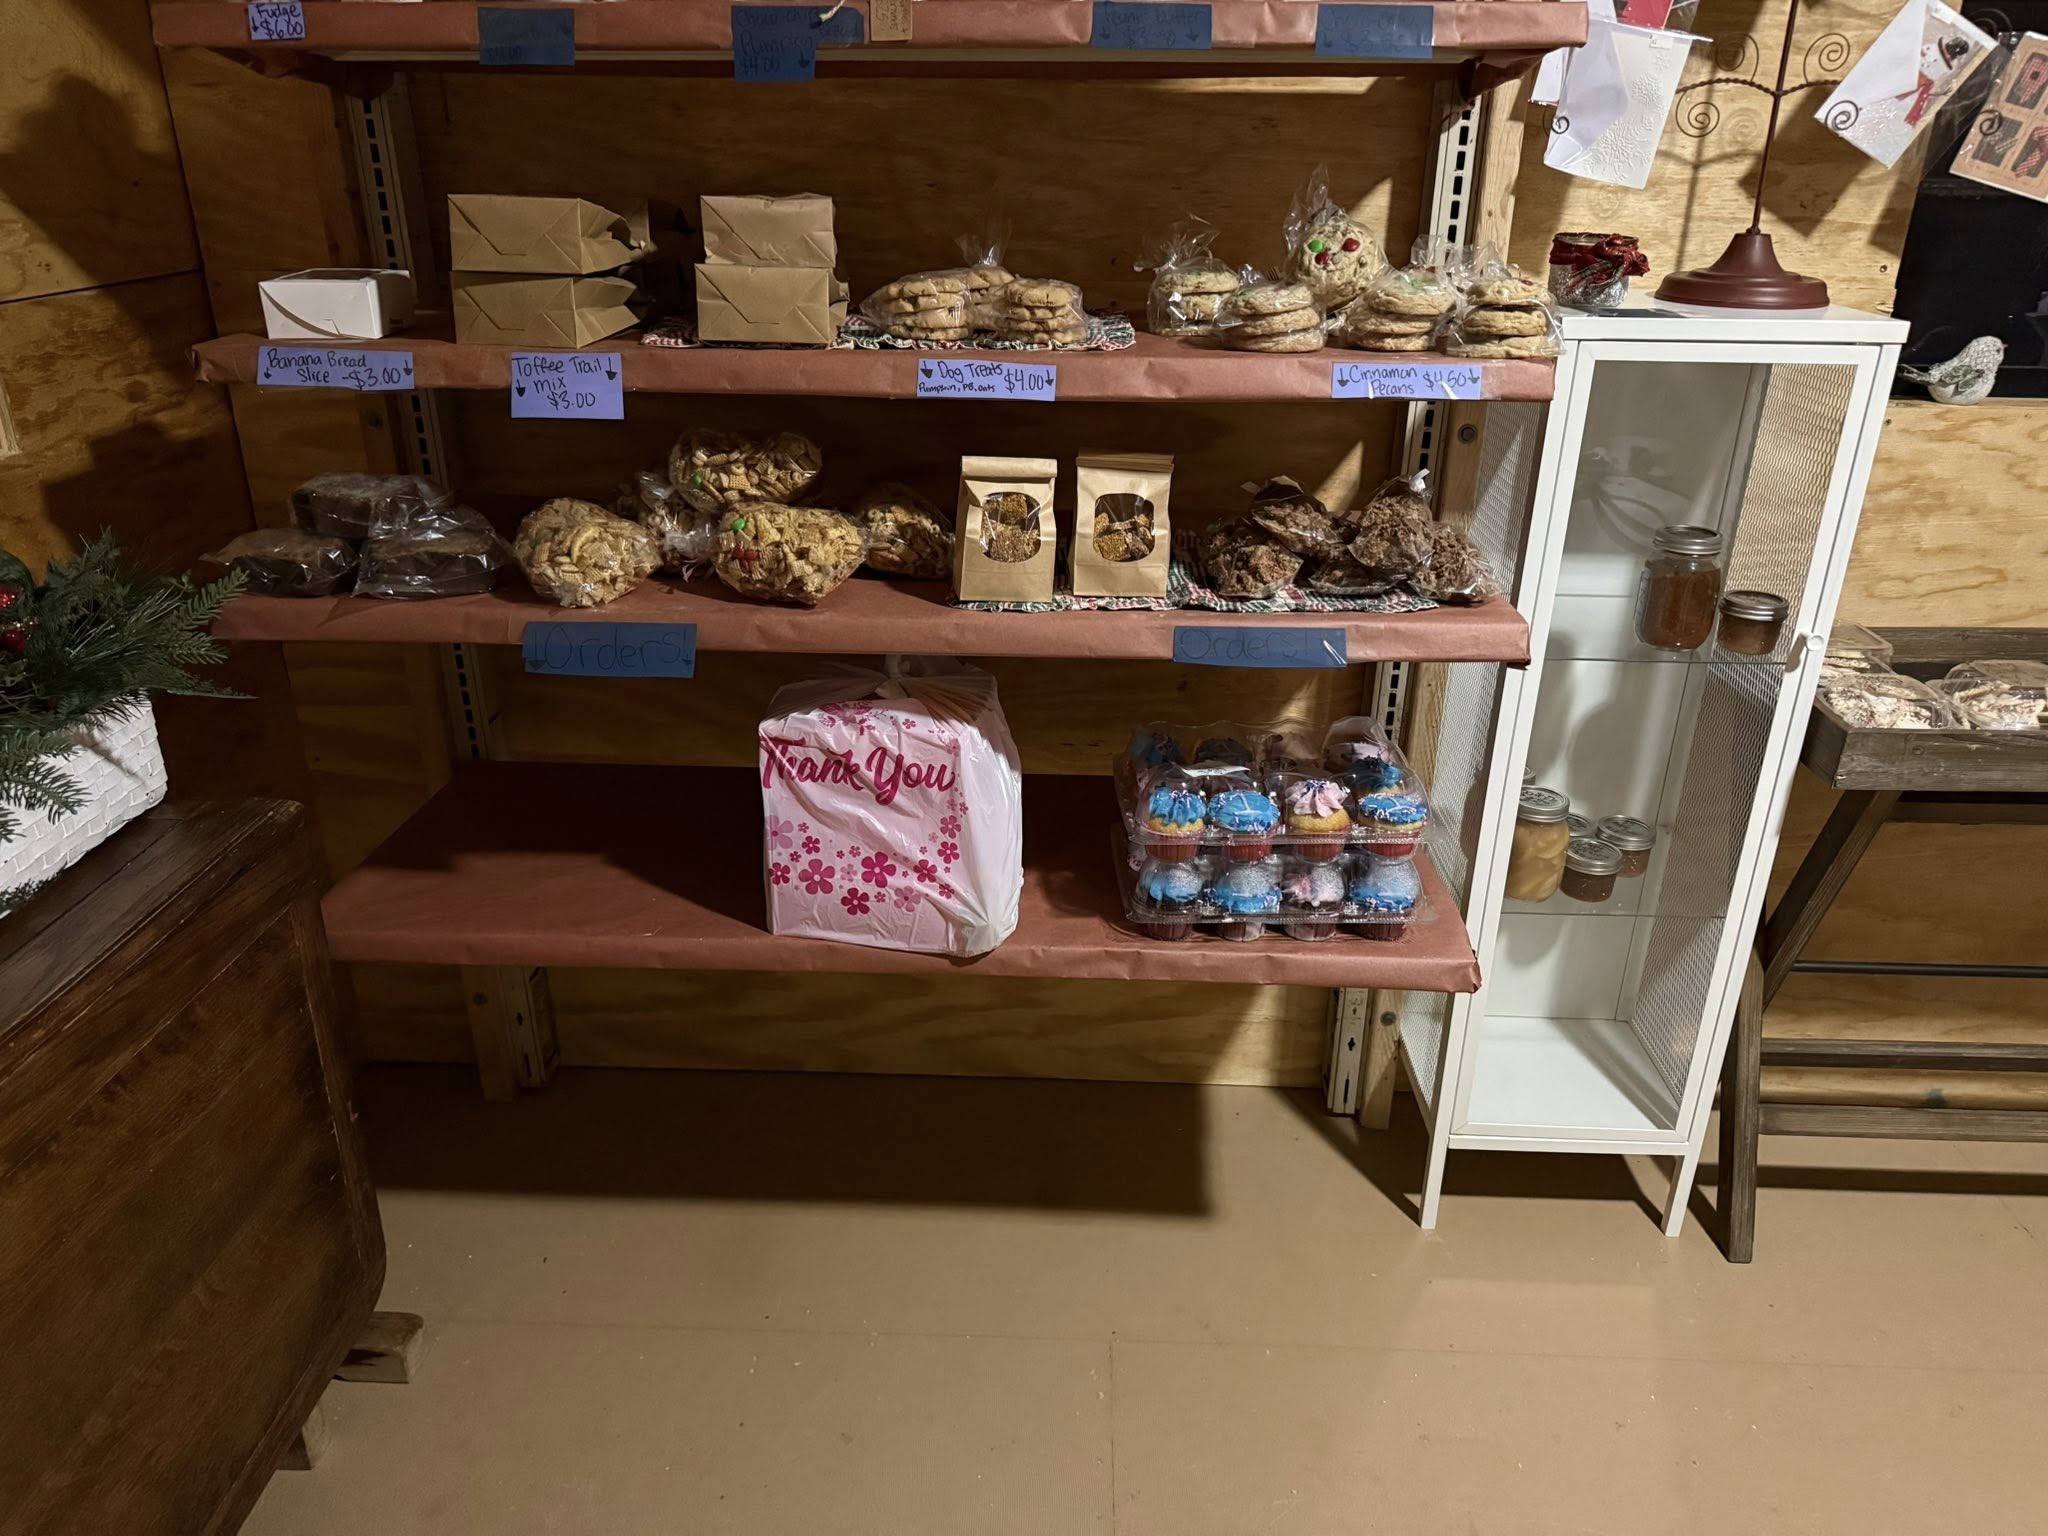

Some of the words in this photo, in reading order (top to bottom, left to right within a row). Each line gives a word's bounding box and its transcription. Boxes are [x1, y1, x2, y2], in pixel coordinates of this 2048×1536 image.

[255, 3, 301, 24] Fudge
[267, 348, 322, 369] Banana
[327, 350, 367, 367] Bread
[511, 356, 566, 376] Toffee
[569, 356, 602, 374] Trail
[937, 361, 964, 383] Dog
[964, 362, 1003, 378] Treats
[1004, 368, 1044, 393] $4.00
[1349, 364, 1418, 383] Cinnamon
[1422, 370, 1466, 391] $450
[1371, 378, 1415, 395] Pecans
[547, 390, 595, 410] $3.00
[760, 736, 864, 790] Thank
[865, 746, 956, 806] You
